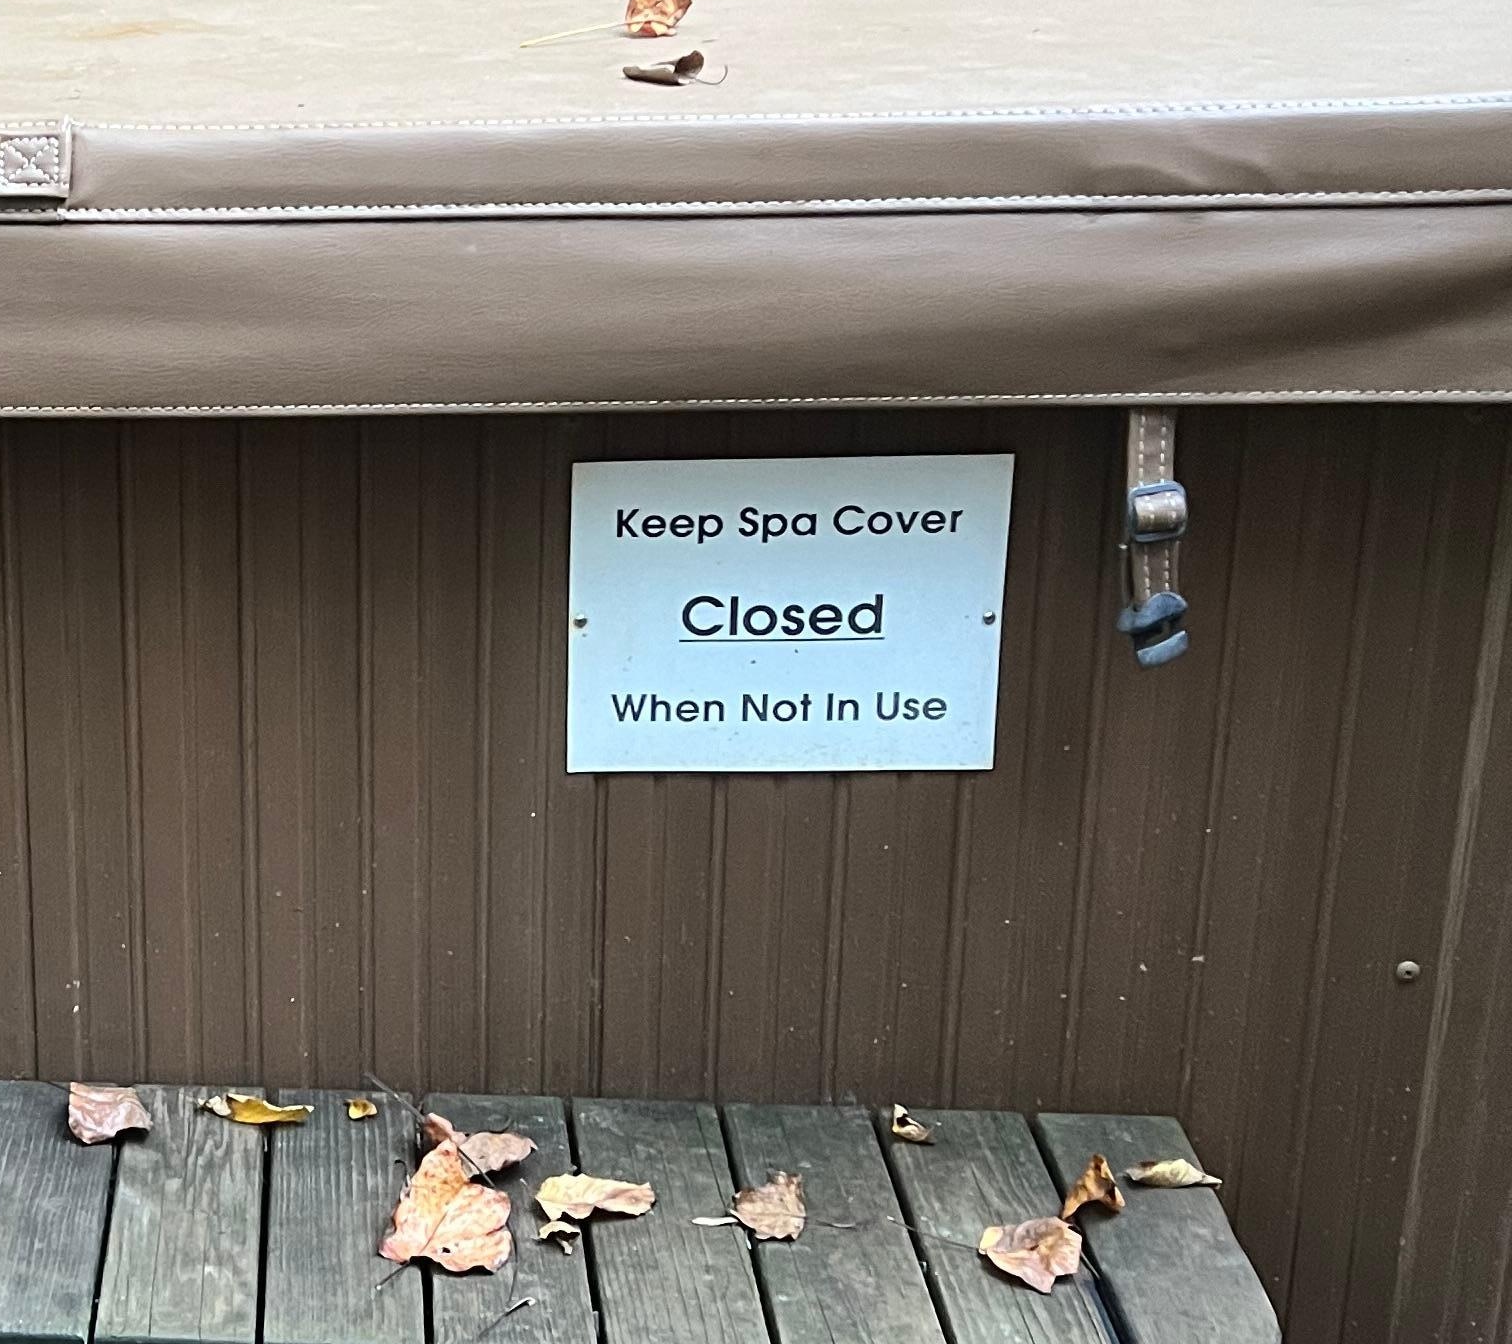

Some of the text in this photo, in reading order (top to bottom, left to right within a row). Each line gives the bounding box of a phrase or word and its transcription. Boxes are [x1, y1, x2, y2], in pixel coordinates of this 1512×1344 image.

[615, 504, 964, 544] Keep Spa Cover
[681, 593, 885, 637] Closed
[611, 691, 948, 723] When Not In Use
